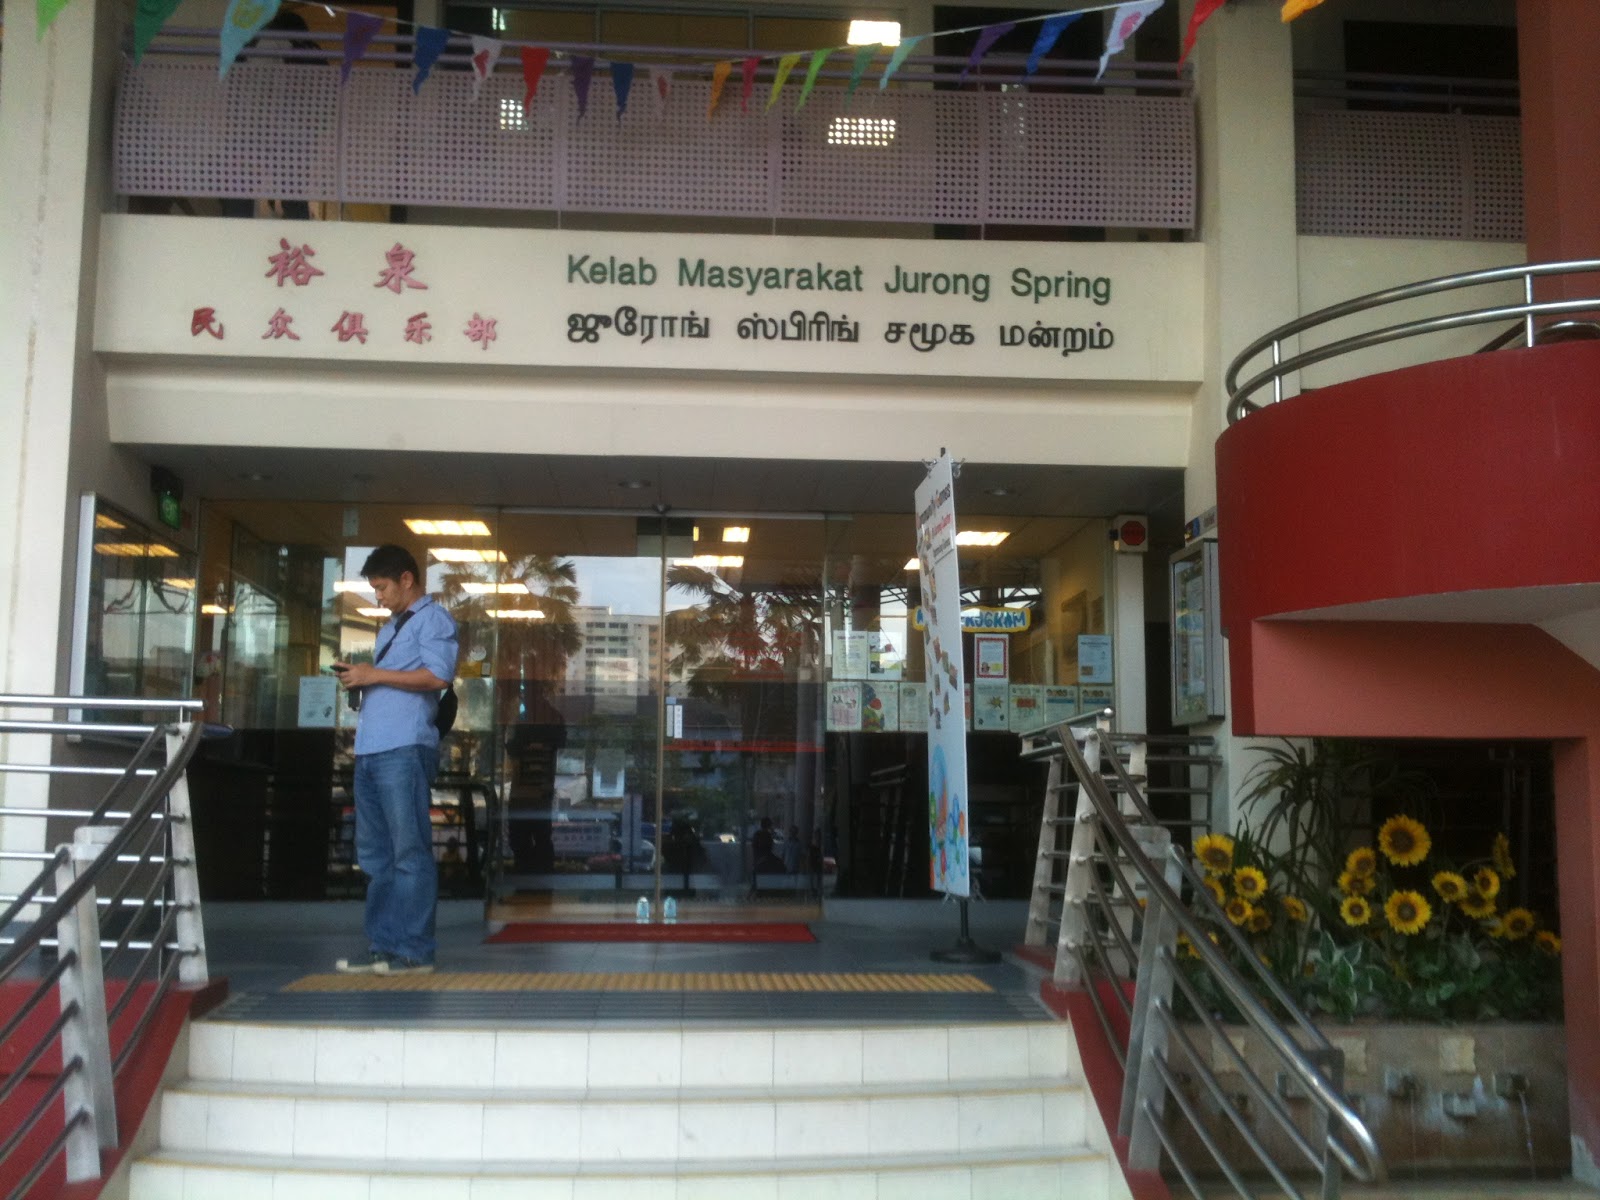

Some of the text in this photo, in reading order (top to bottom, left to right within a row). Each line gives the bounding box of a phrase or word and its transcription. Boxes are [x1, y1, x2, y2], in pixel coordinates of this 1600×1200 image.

[265, 236, 429, 293] 裕泉
[567, 254, 1112, 307] Kelab Masyarakat Jurong Spring
[190, 306, 498, 351] 民众俱乐部
[883, 320, 976, 353] சமூக
[998, 319, 1116, 358] மன்றம்
